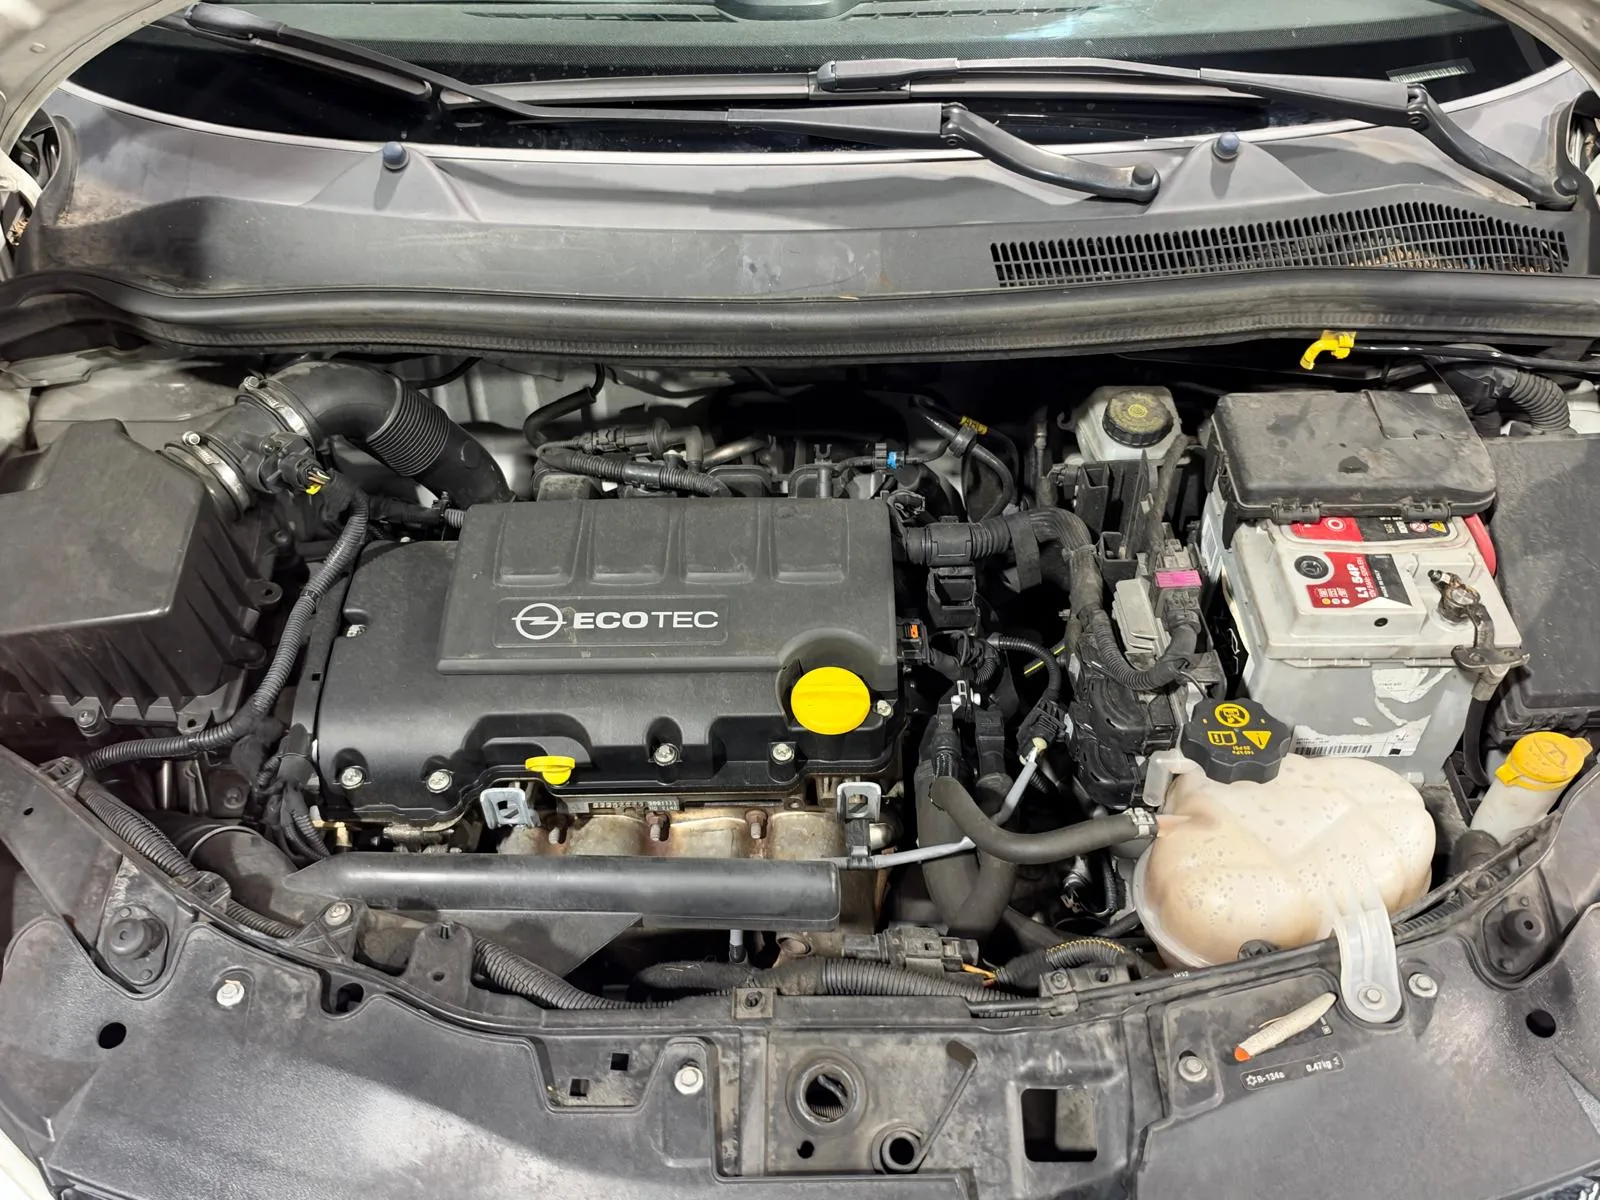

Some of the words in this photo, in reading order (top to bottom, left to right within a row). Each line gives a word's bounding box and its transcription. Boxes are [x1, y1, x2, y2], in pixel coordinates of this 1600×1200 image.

[573, 611, 719, 629] ECOTEC
[1256, 1071, 1285, 1083] R-134a
[1305, 1059, 1333, 1073] 0.47kg
